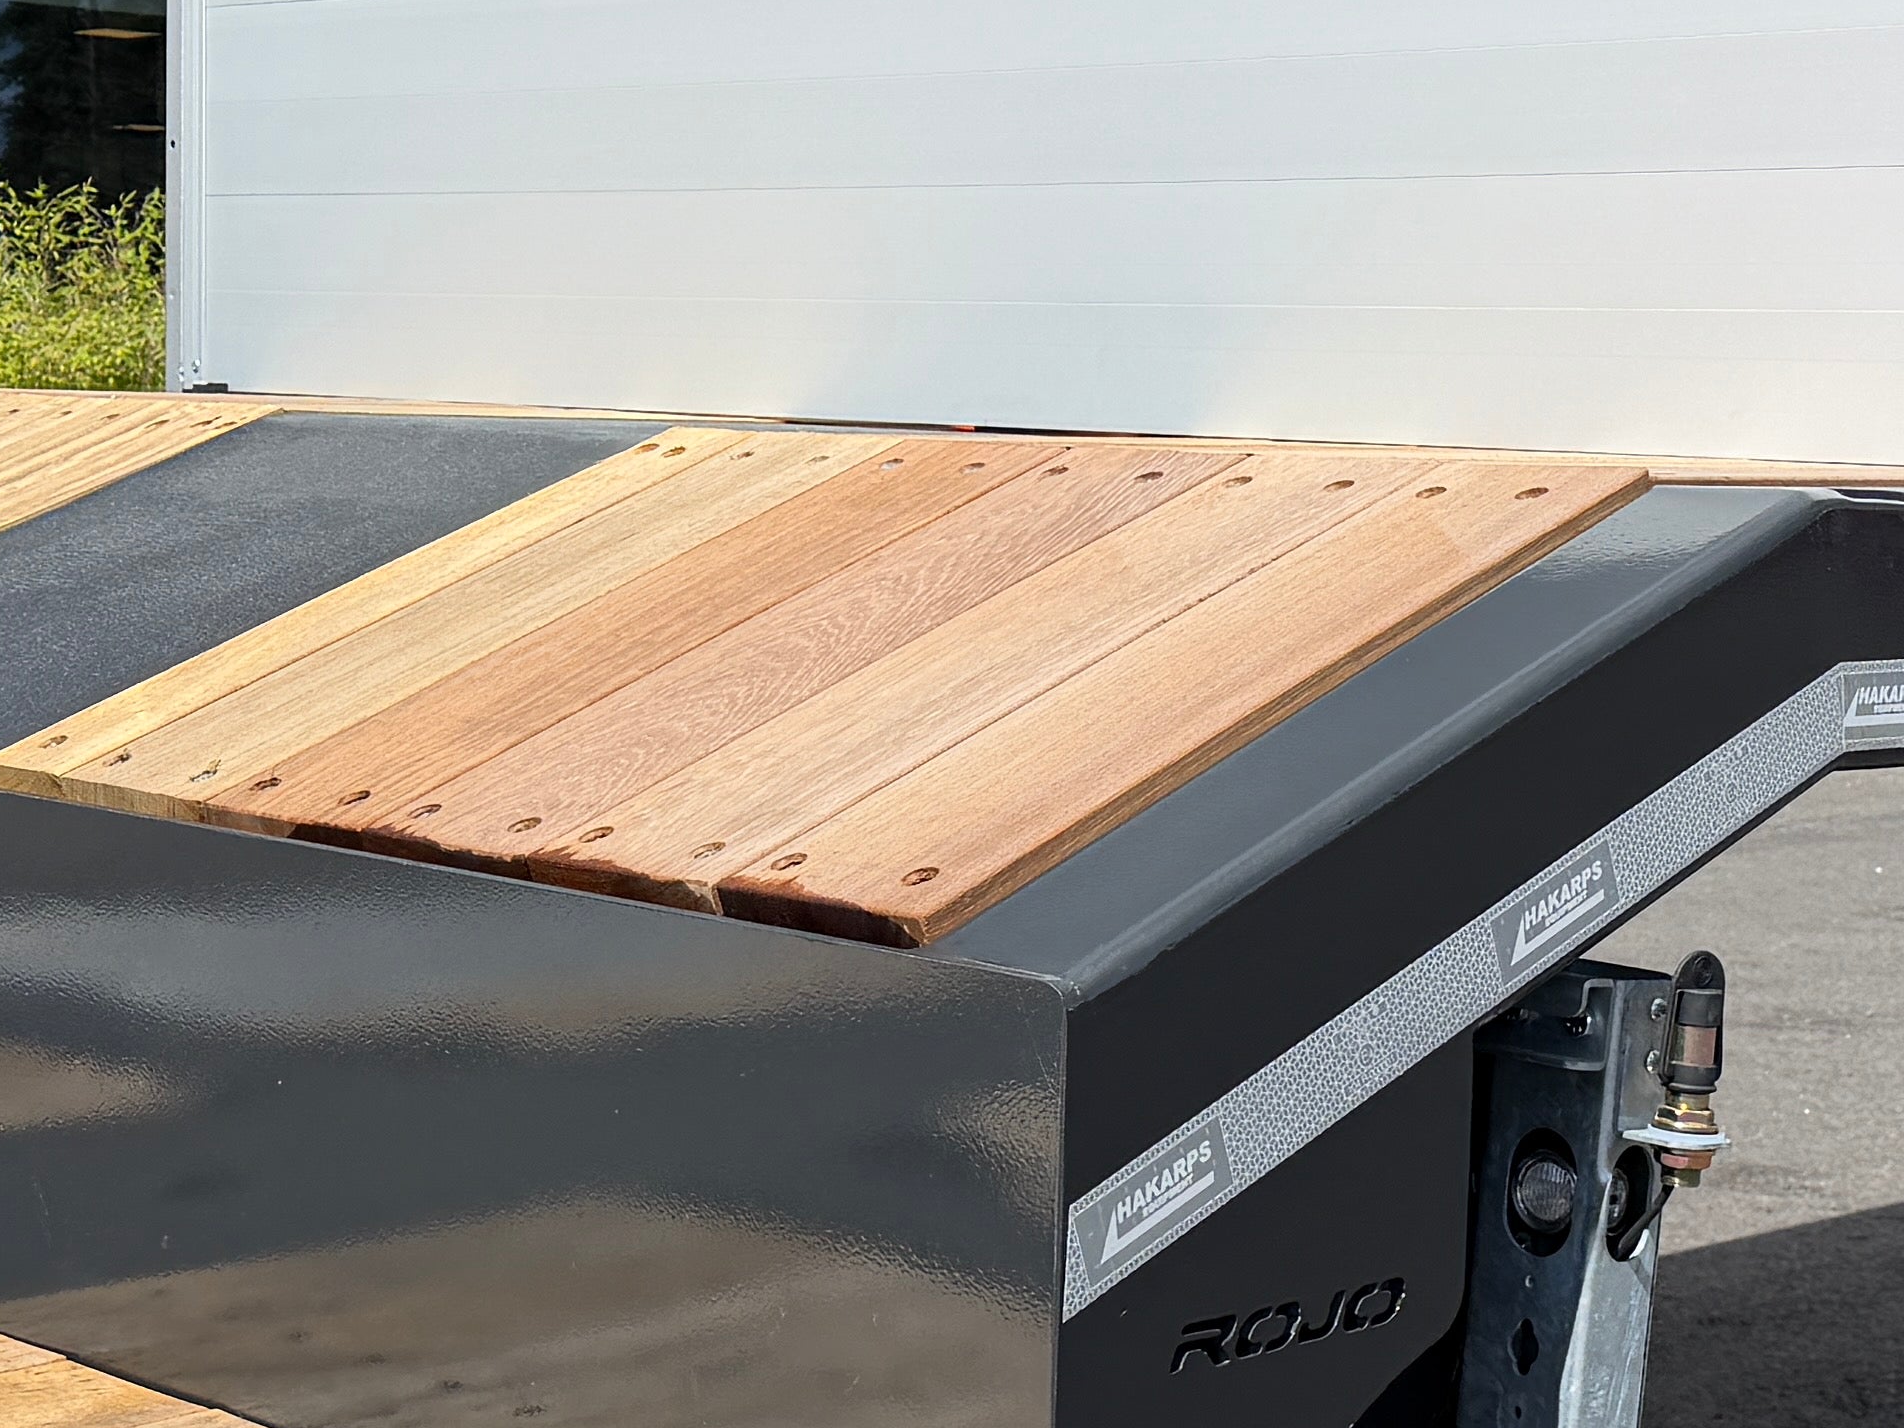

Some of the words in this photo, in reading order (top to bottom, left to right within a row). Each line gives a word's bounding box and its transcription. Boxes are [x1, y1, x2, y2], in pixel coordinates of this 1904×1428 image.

[1524, 860, 1603, 931] HAKARPS
[1117, 1139, 1212, 1225] HAKARPS
[1169, 1276, 1406, 1375] ROJO
